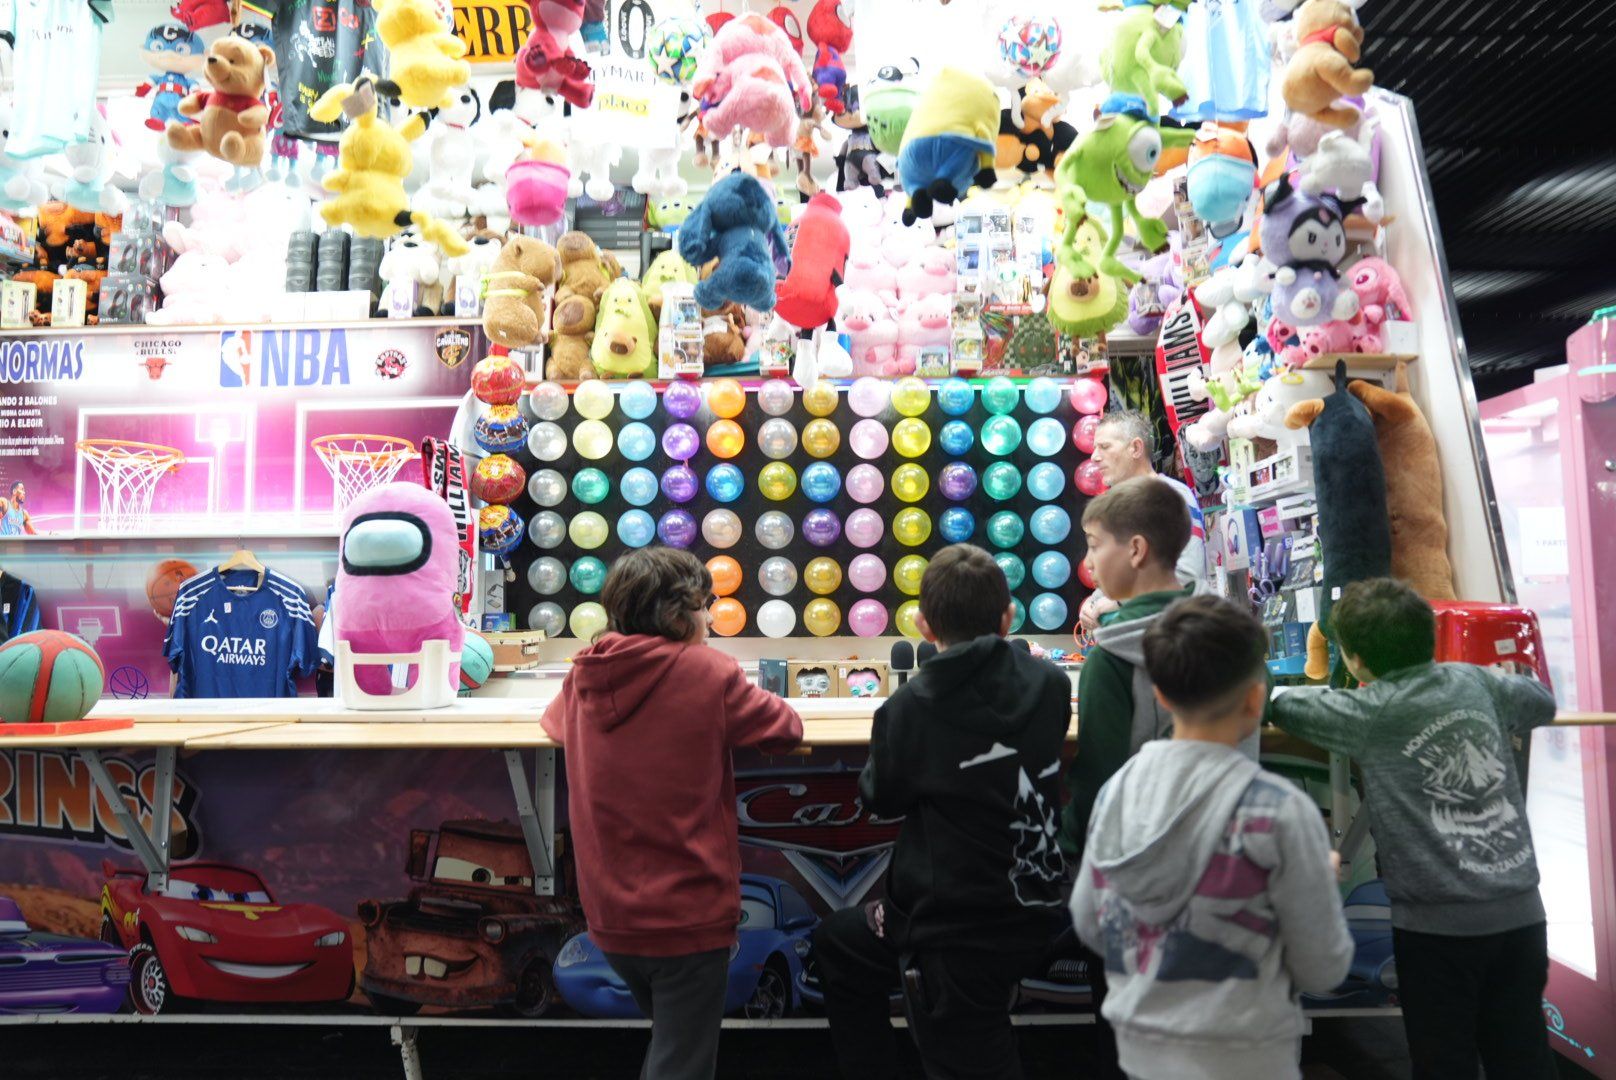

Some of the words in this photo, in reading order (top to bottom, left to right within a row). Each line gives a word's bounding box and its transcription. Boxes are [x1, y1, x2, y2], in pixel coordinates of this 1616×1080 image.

[134, 340, 181, 348] CHICAGO
[0, 341, 85, 383] NORMAS
[260, 328, 350, 387] NBA
[18, 396, 24, 406] 2
[25, 395, 58, 406] BALONES
[17, 418, 43, 428] ELEGIR
[201, 635, 266, 656] QATAR
[216, 653, 266, 666] AIRWAYS
